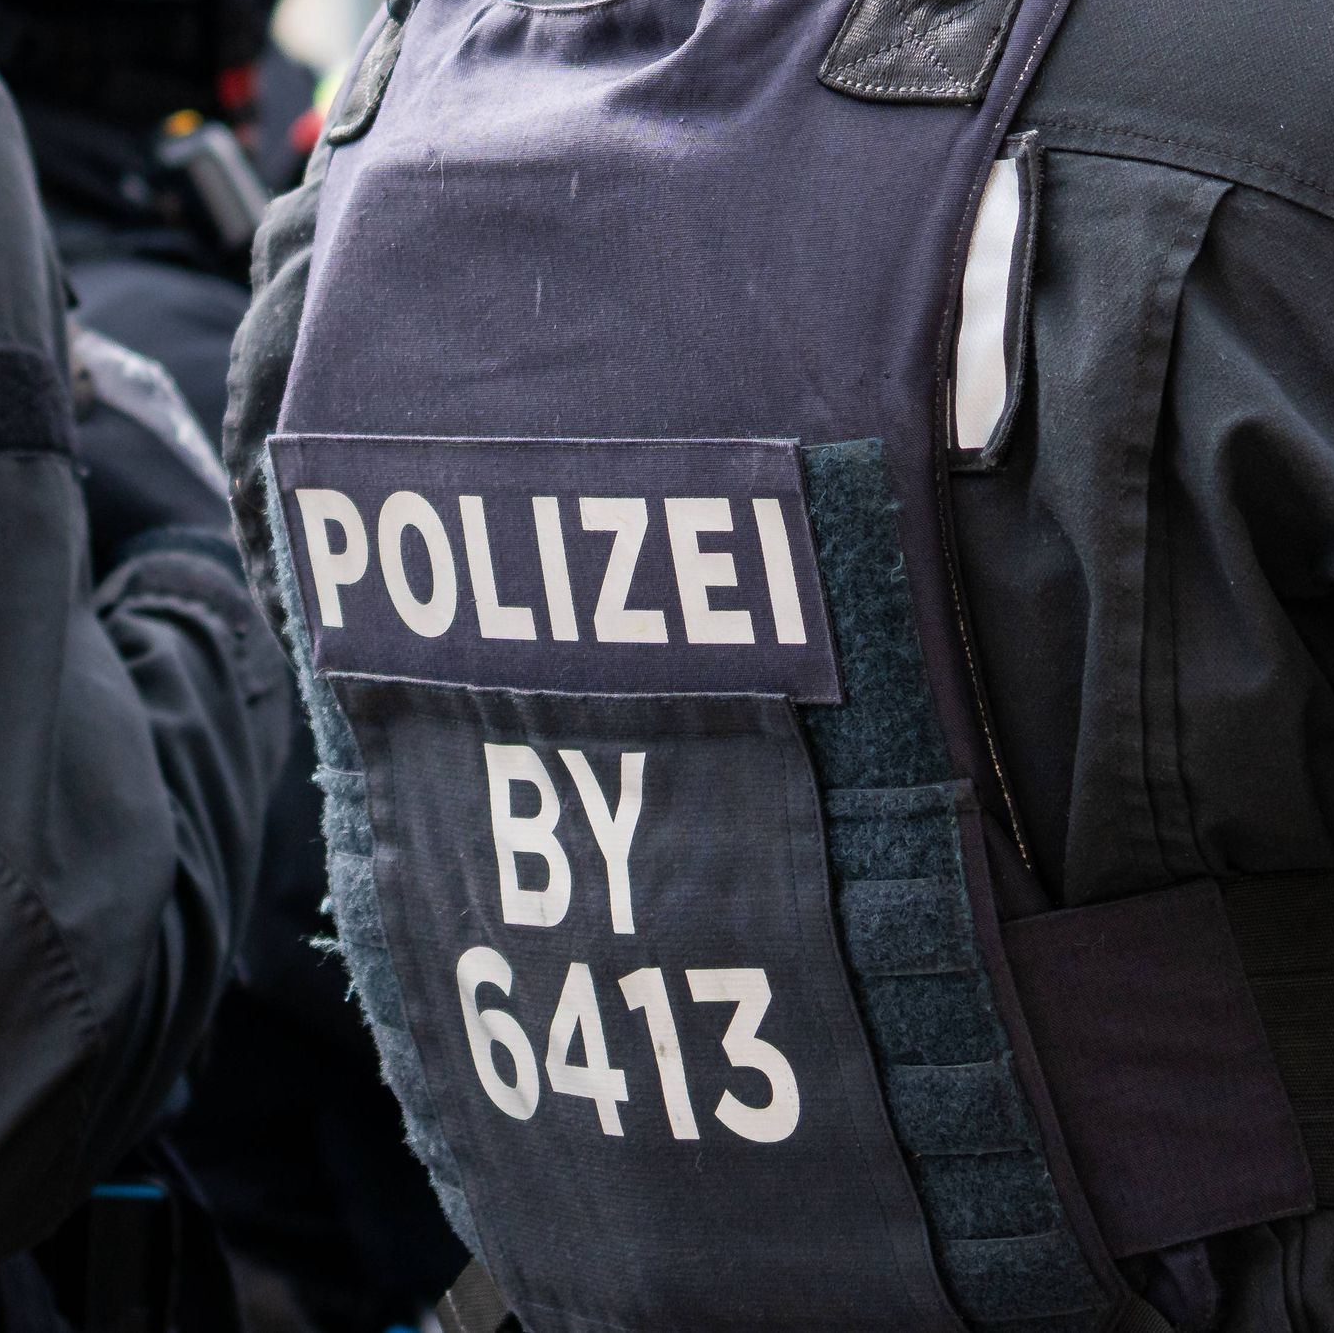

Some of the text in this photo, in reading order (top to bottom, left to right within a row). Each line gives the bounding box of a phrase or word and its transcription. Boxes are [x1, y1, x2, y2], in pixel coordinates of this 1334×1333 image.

[294, 488, 808, 645] POLIZEI
[483, 742, 647, 935] BY
[456, 945, 801, 1143] 6413
